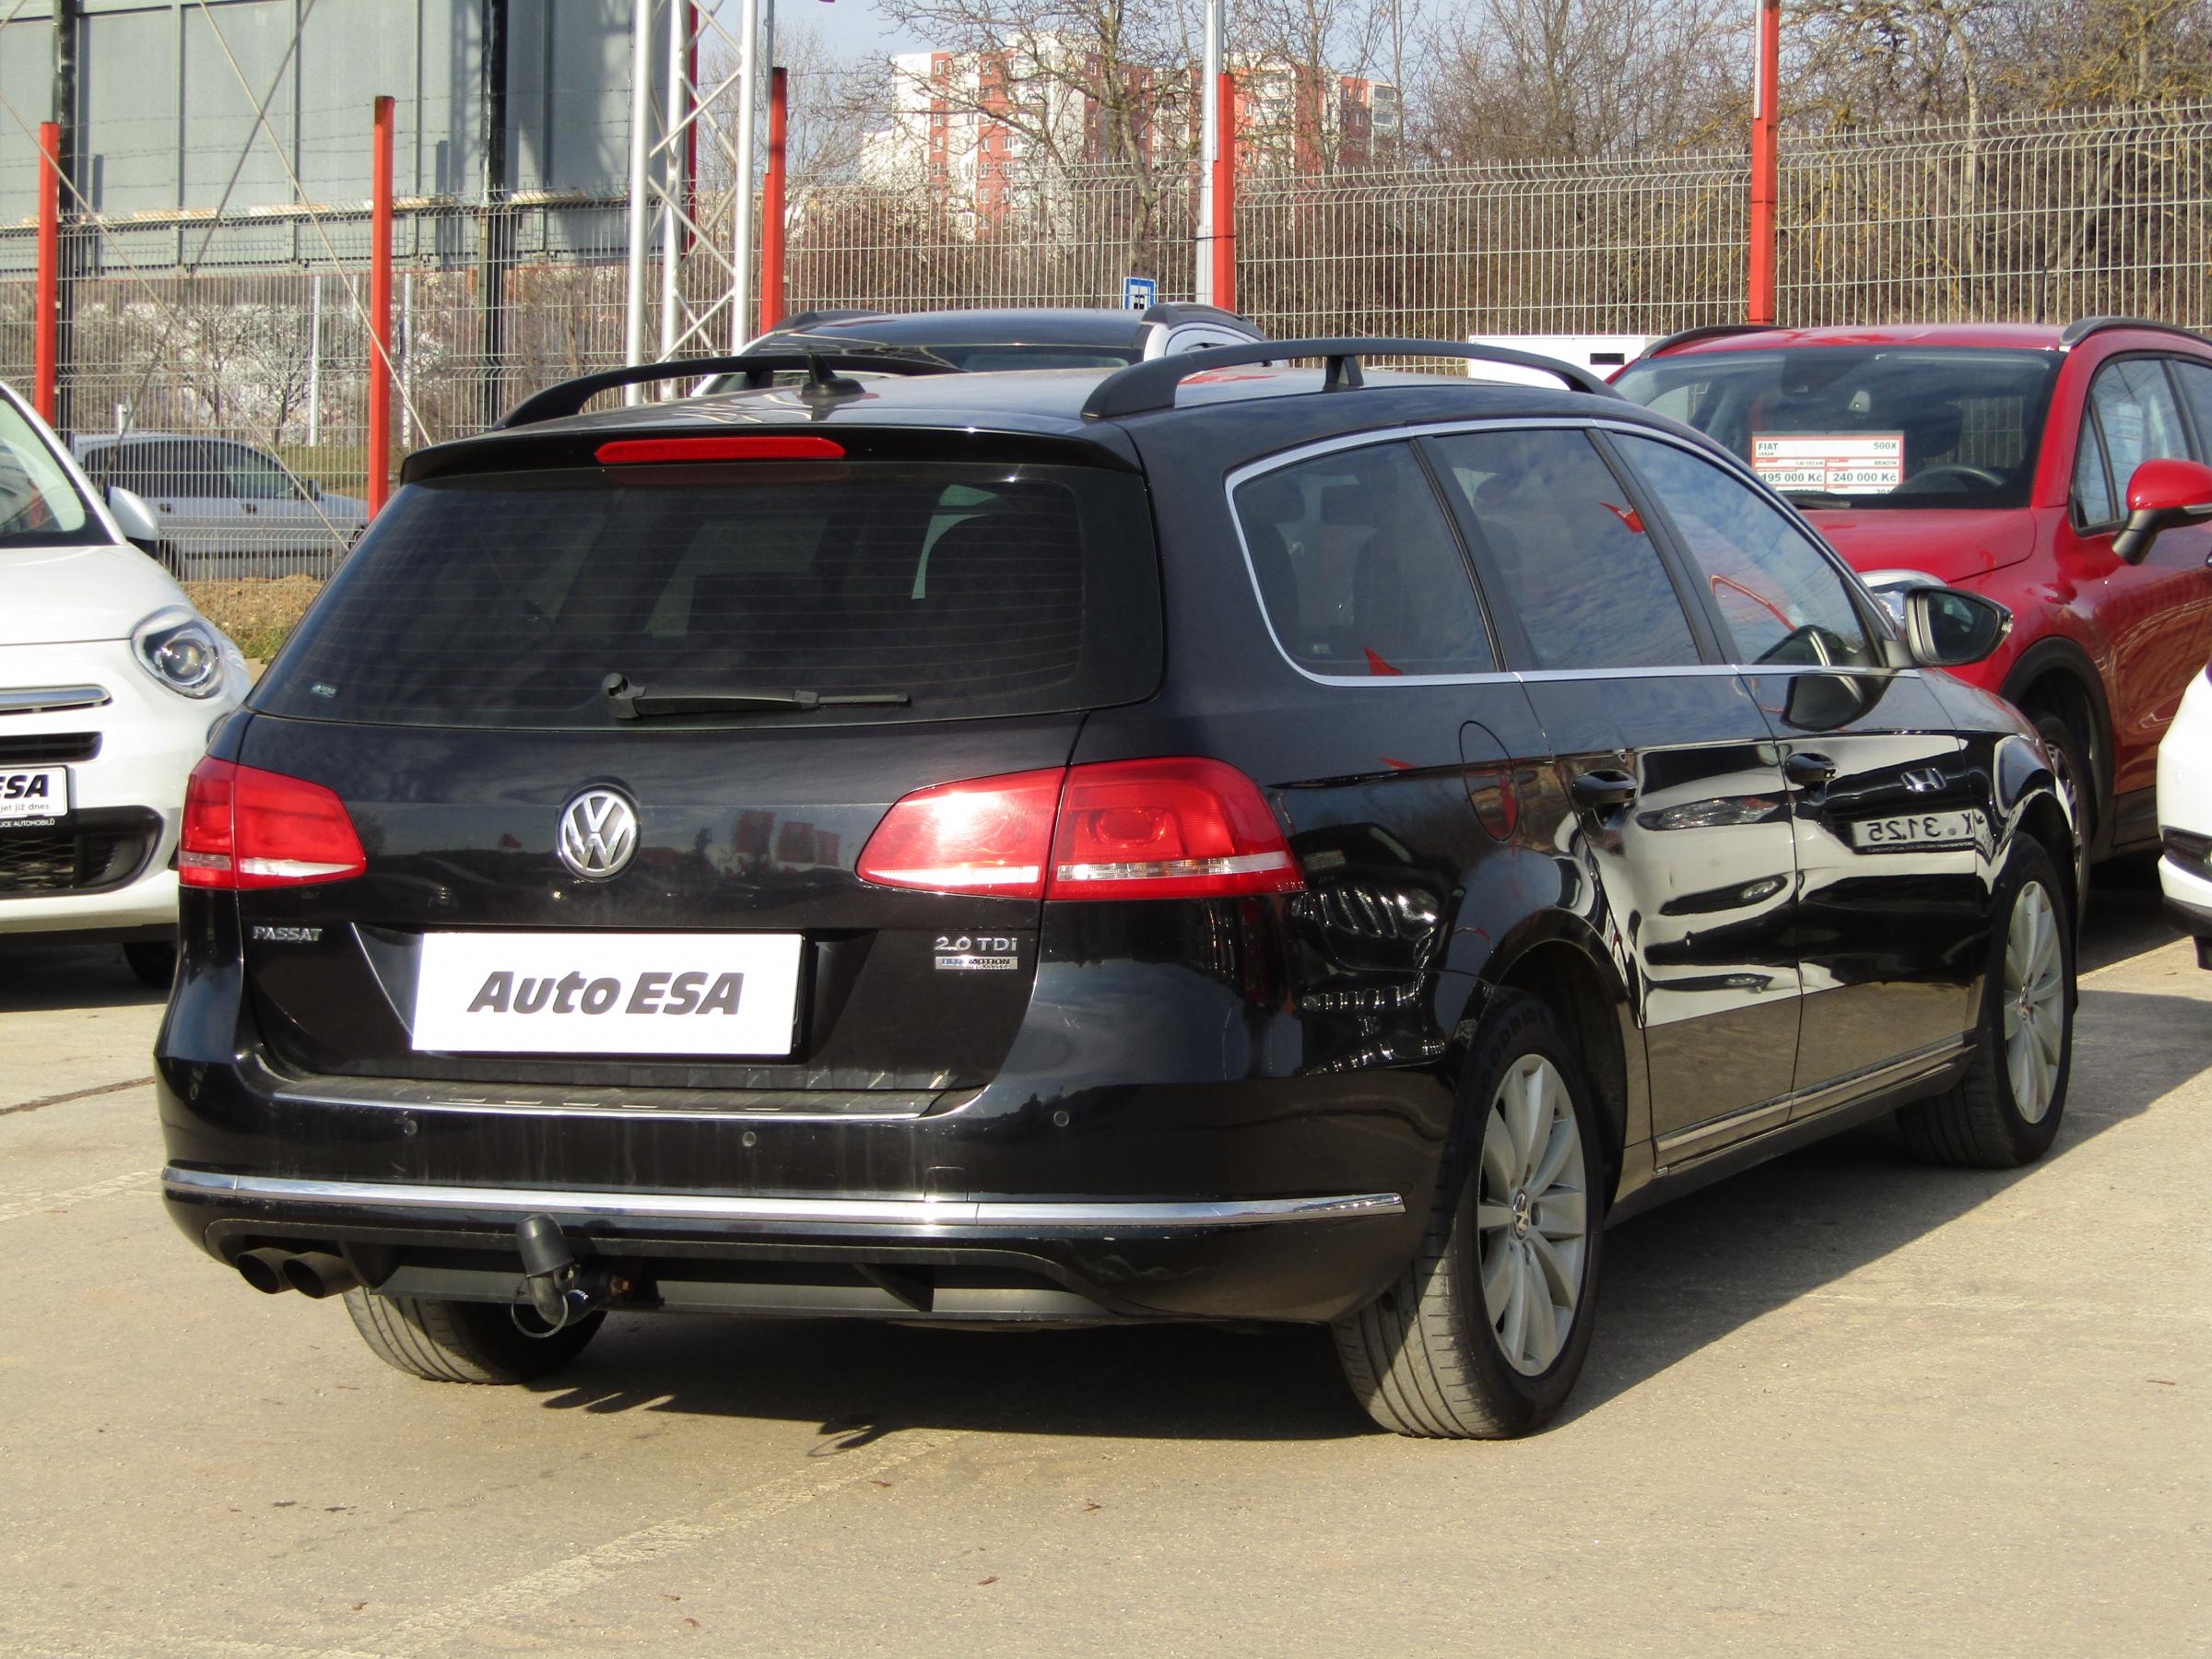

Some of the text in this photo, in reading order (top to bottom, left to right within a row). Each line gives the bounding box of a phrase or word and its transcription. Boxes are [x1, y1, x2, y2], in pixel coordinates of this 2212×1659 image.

[1758, 442, 1779, 451] FIAT
[1873, 441, 1898, 450] 500X
[1761, 473, 1823, 482] 195 000 Kč
[1832, 472, 1897, 482] 240 000 Kč
[28, 803, 50, 812] dnes
[13, 818, 55, 828] AUTOMOBILŮ
[253, 925, 323, 942] PASSAT
[466, 971, 745, 1016] Auto ESA
